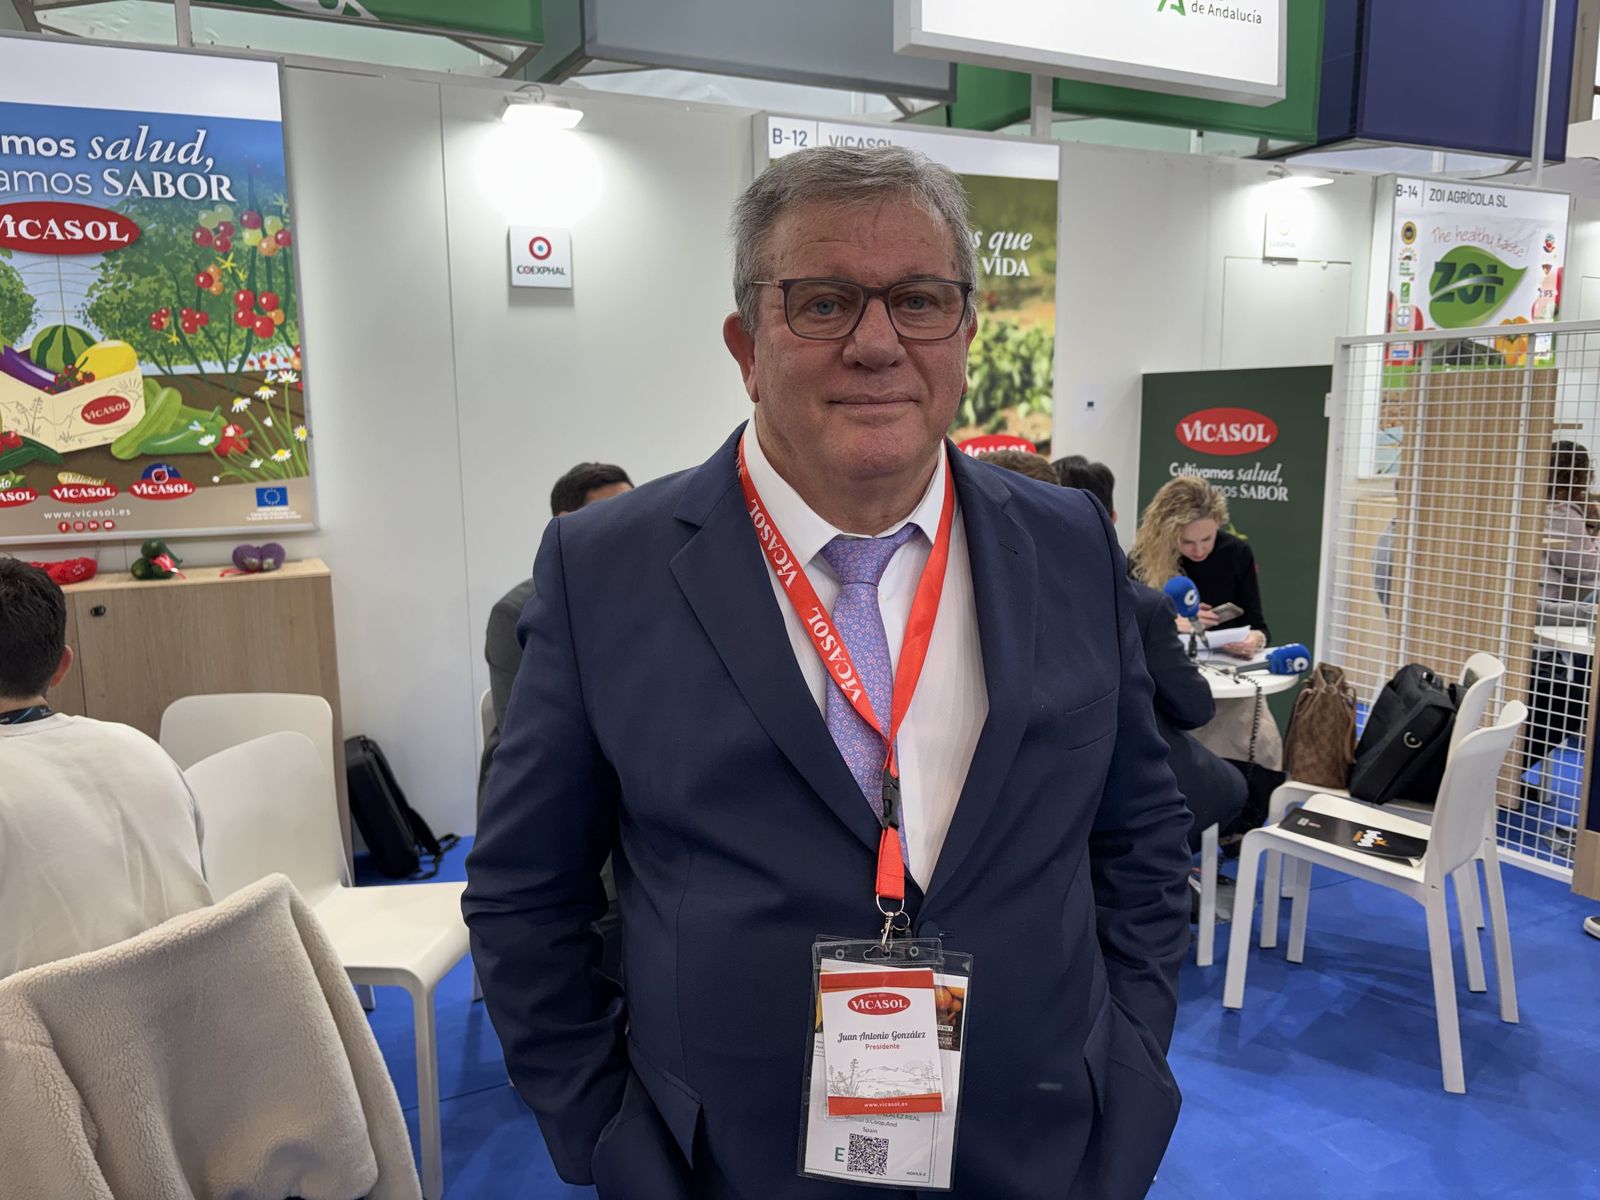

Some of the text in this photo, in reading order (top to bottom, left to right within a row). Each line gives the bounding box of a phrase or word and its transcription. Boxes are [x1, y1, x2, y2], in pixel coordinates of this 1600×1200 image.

[1191, 0, 1262, 24] de Andalucía
[772, 128, 808, 147] B-12
[87, 125, 214, 173] salud,
[103, 168, 237, 202] SABOR
[1396, 184, 1508, 208] B-14 ZOI AGRÍCOLA SL
[988, 230, 1034, 258] que
[1455, 224, 1495, 250] healthy
[516, 264, 566, 276] COEXPHAL
[981, 256, 1031, 277] VIDA
[83, 401, 129, 421] VICASOL
[1182, 420, 1271, 443] VICASOL
[1169, 462, 1283, 486] Cultivamos salud,
[53, 486, 116, 500] VICASOL
[132, 482, 193, 496] VICASOL
[1239, 483, 1289, 502] SABOR
[43, 507, 132, 520] www.vicasol.es
[749, 498, 798, 589] VICASOL
[807, 606, 862, 703] VICASOL
[851, 998, 908, 1011] VICASOL
[837, 1030, 927, 1043] Juan Antonio González
[865, 1043, 901, 1051] Presidente
[863, 1100, 909, 1108] www.vicasol.es
[862, 1126, 878, 1134] Spain
[834, 1146, 846, 1163] E
